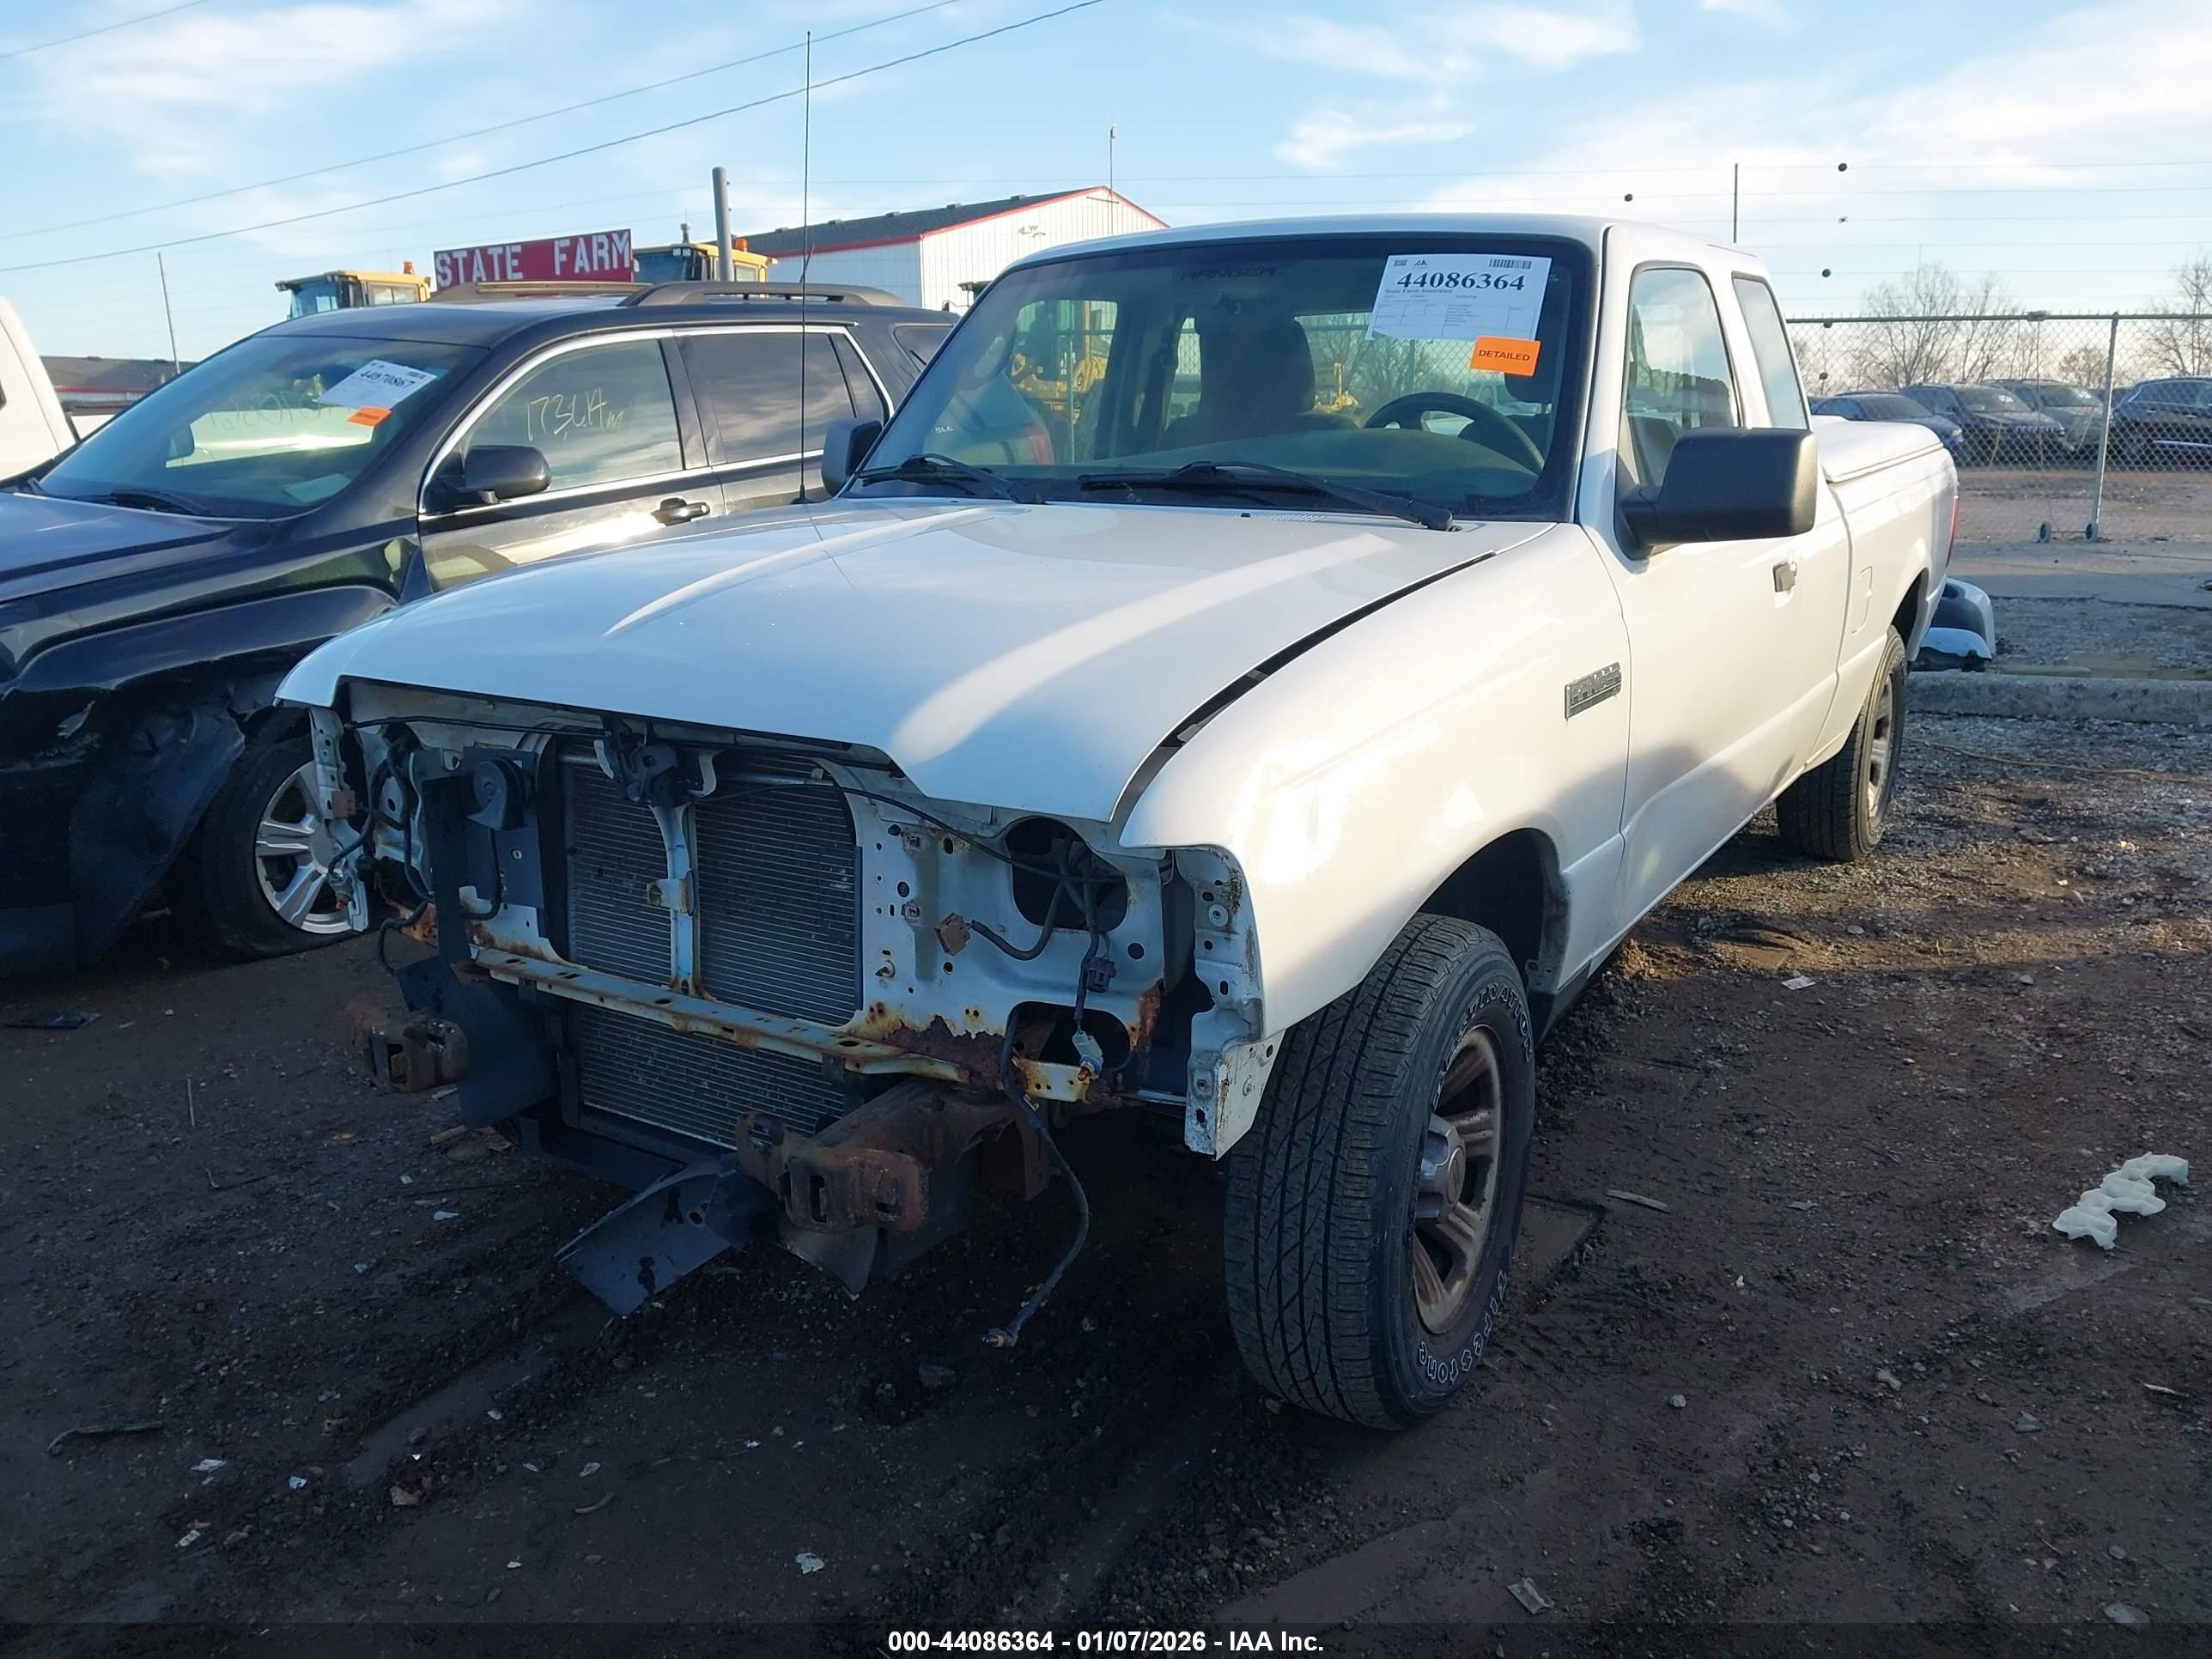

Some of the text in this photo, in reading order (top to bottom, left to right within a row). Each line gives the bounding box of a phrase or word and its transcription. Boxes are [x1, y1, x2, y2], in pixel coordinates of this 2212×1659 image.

[436, 230, 631, 288] STATE FARM
[1397, 272, 1525, 291] 44086364
[1478, 349, 1531, 362] DETAILED
